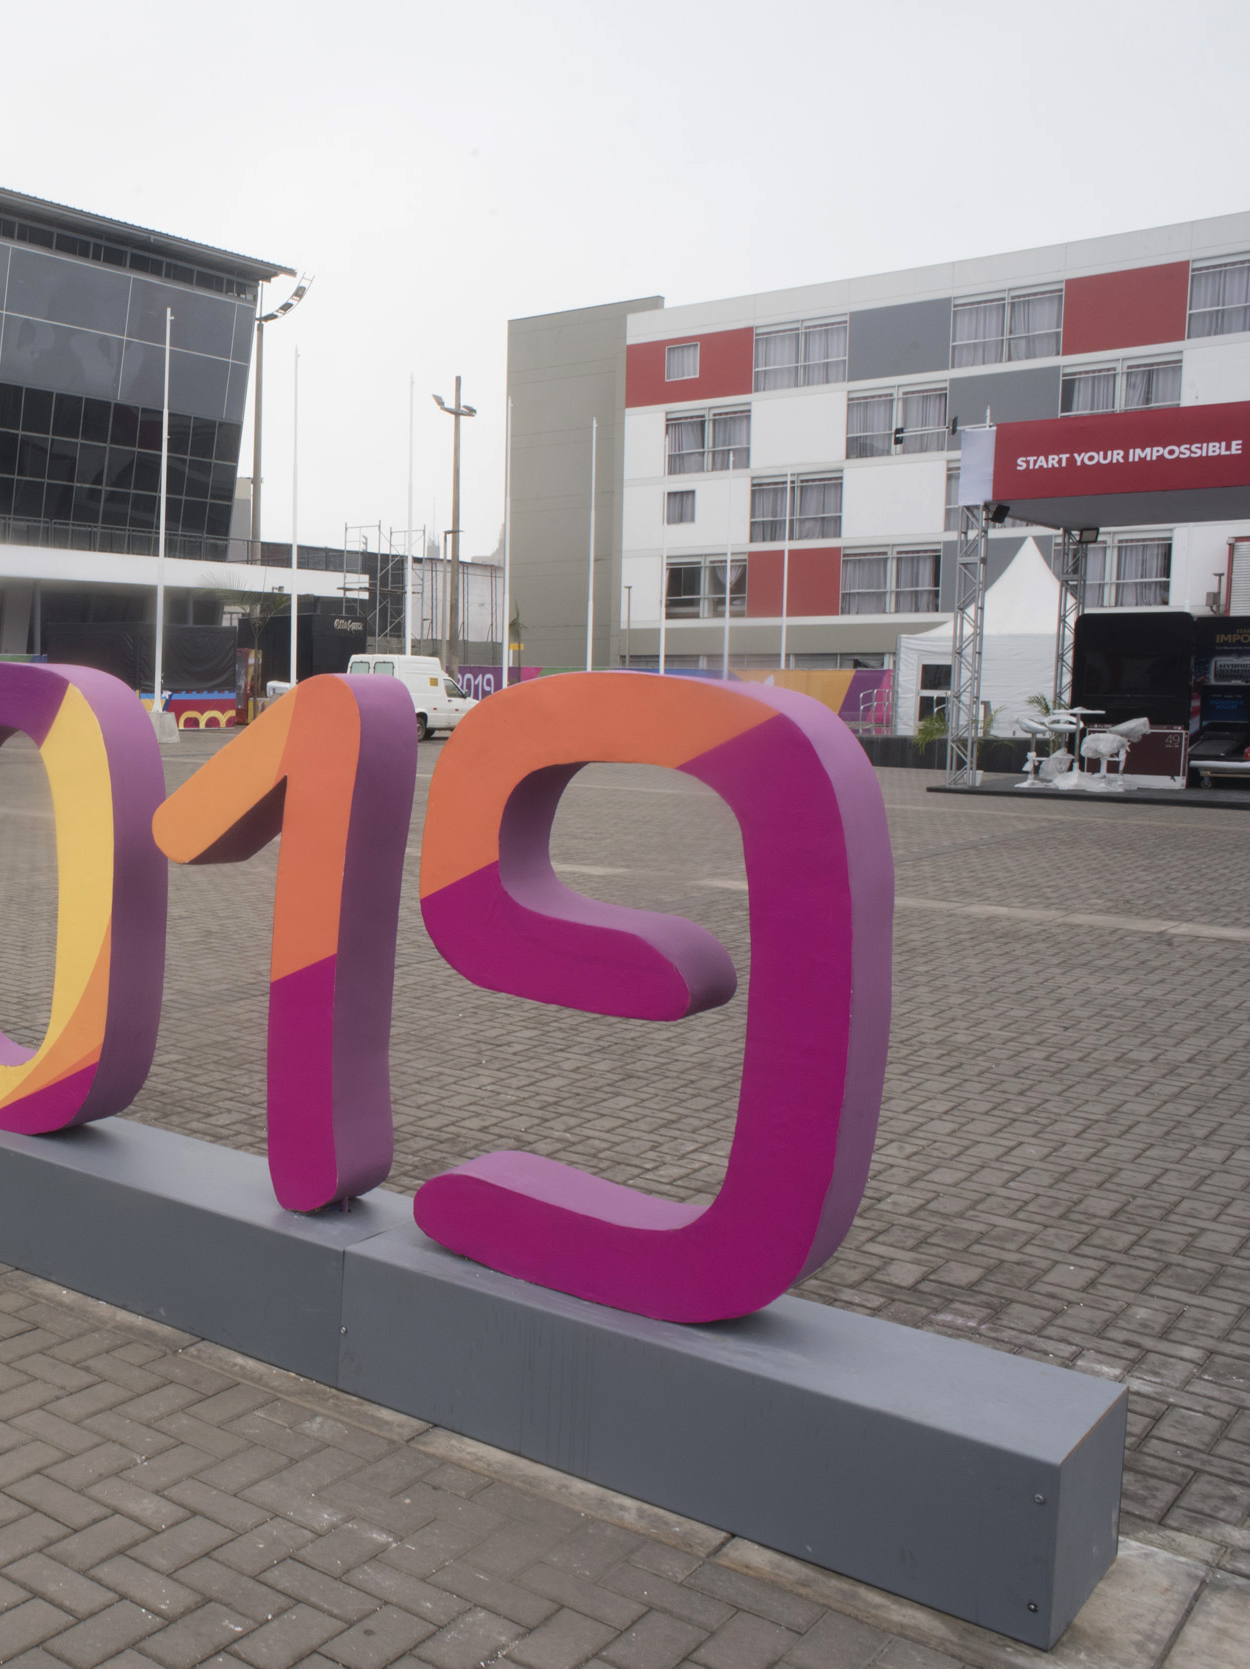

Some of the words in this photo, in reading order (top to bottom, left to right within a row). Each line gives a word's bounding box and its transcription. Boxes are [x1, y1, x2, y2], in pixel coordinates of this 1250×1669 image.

[1016, 454, 1069, 470] START
[1073, 449, 1125, 466] YOUR
[1129, 440, 1243, 462] IMPOSSIBLE
[457, 673, 494, 702] 019
[1165, 734, 1181, 744] 49
